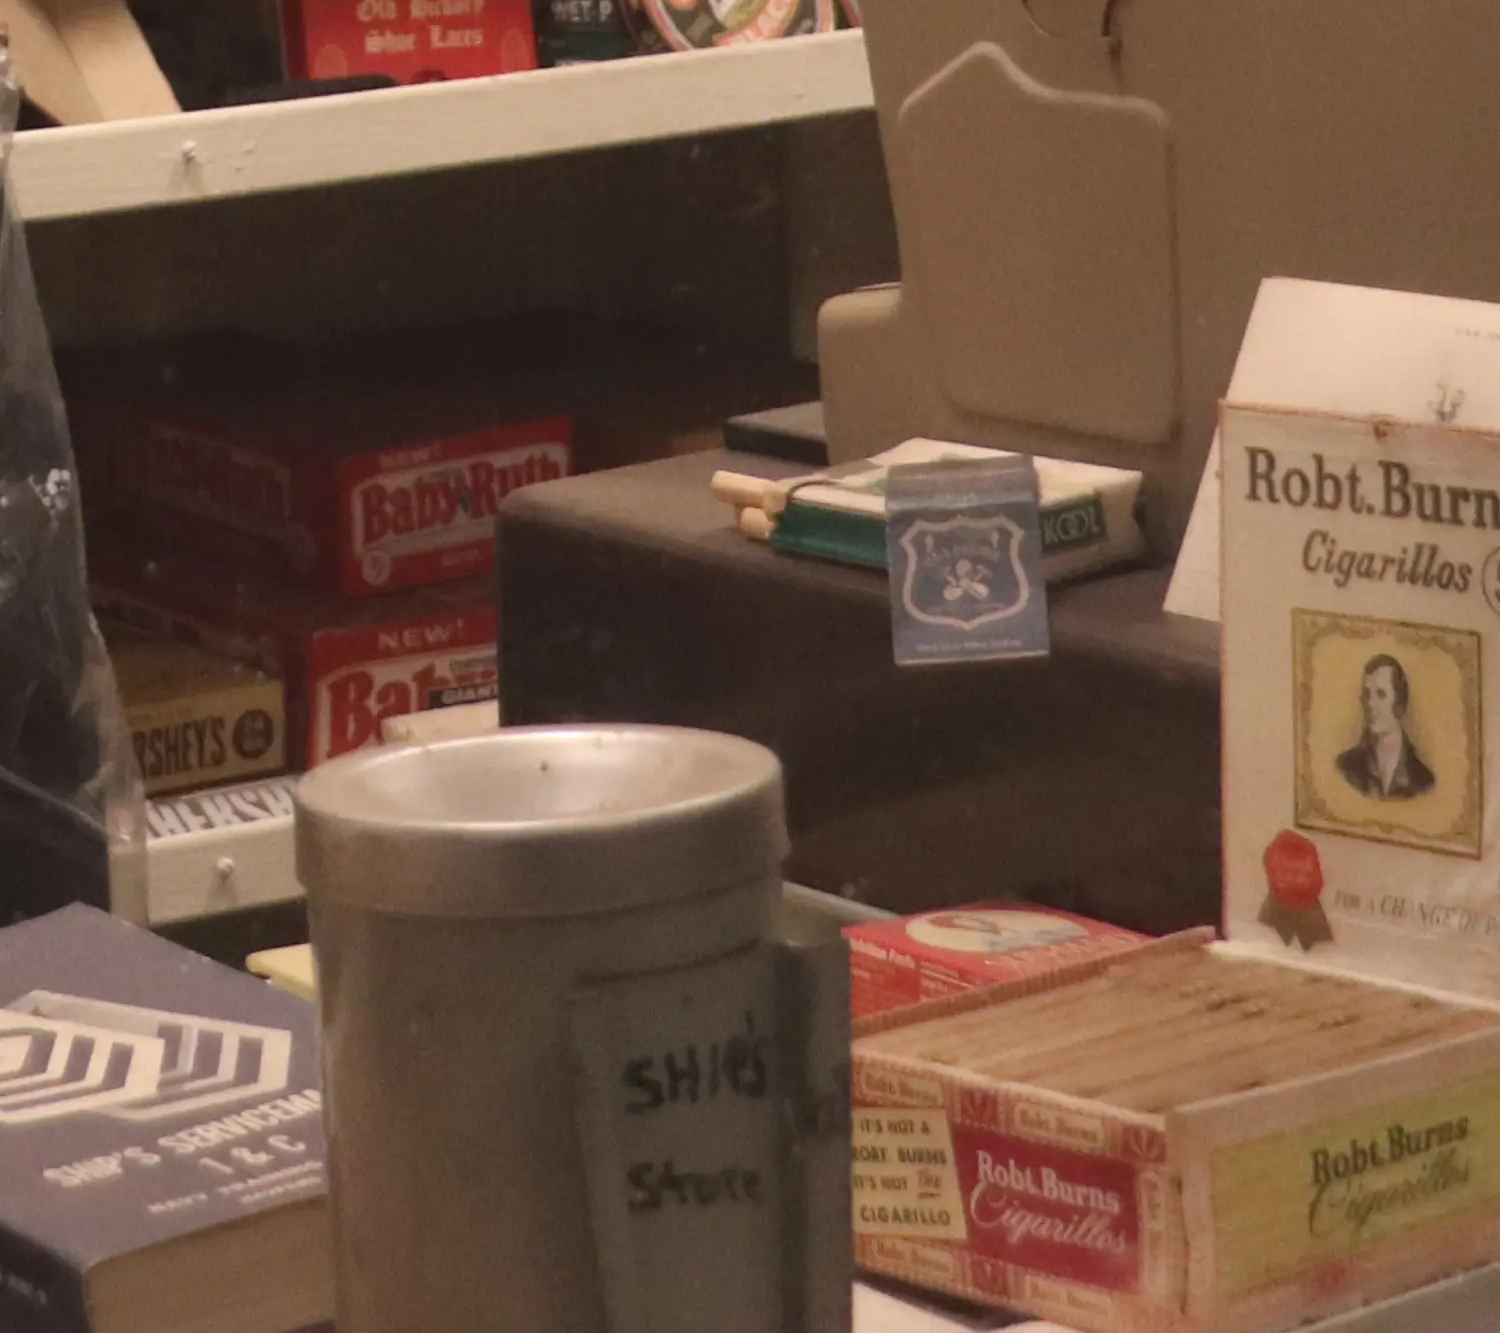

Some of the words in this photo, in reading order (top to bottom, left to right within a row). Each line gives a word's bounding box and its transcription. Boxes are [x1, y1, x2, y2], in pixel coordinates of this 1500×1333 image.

[359, 467, 462, 546] Baby
[1042, 508, 1101, 545] KOOL
[1302, 529, 1473, 598] Cigarillos
[860, 1206, 950, 1225] CIGARILLO
[970, 1182, 1127, 1252] Cigarillos
[1310, 1157, 1473, 1233] Cigarillos
